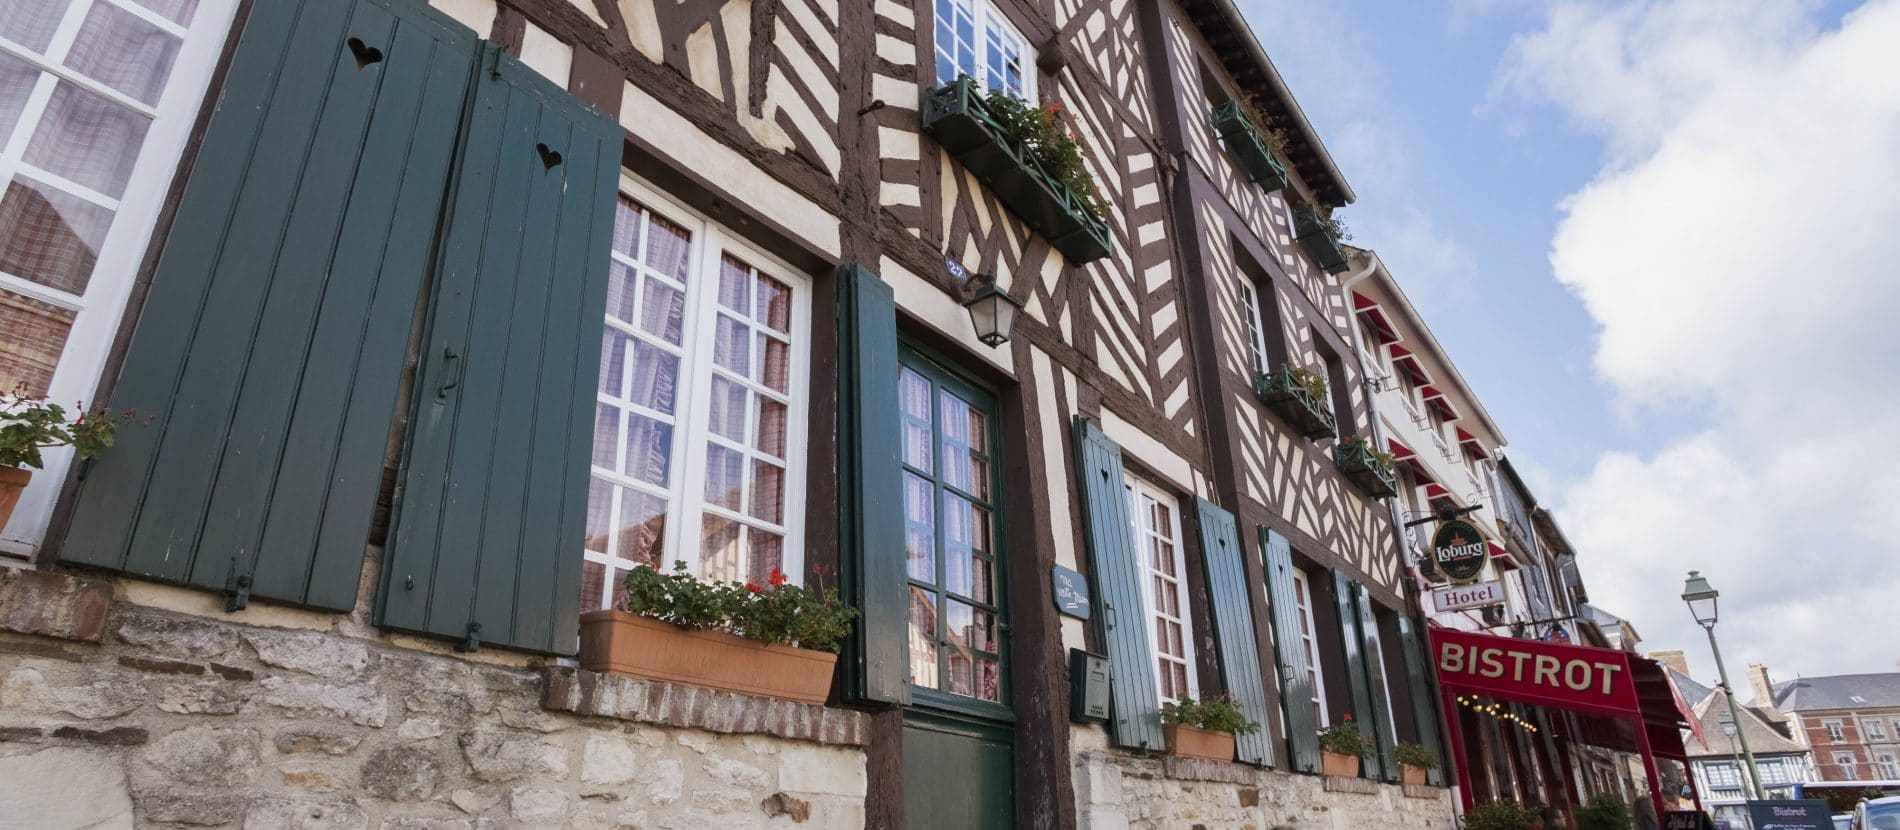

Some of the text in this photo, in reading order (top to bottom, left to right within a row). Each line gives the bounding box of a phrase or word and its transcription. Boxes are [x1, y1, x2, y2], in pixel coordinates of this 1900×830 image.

[1436, 542, 1483, 562] Loburg
[1444, 587, 1494, 606] Hotel
[1440, 642, 1621, 695] BISTROT
